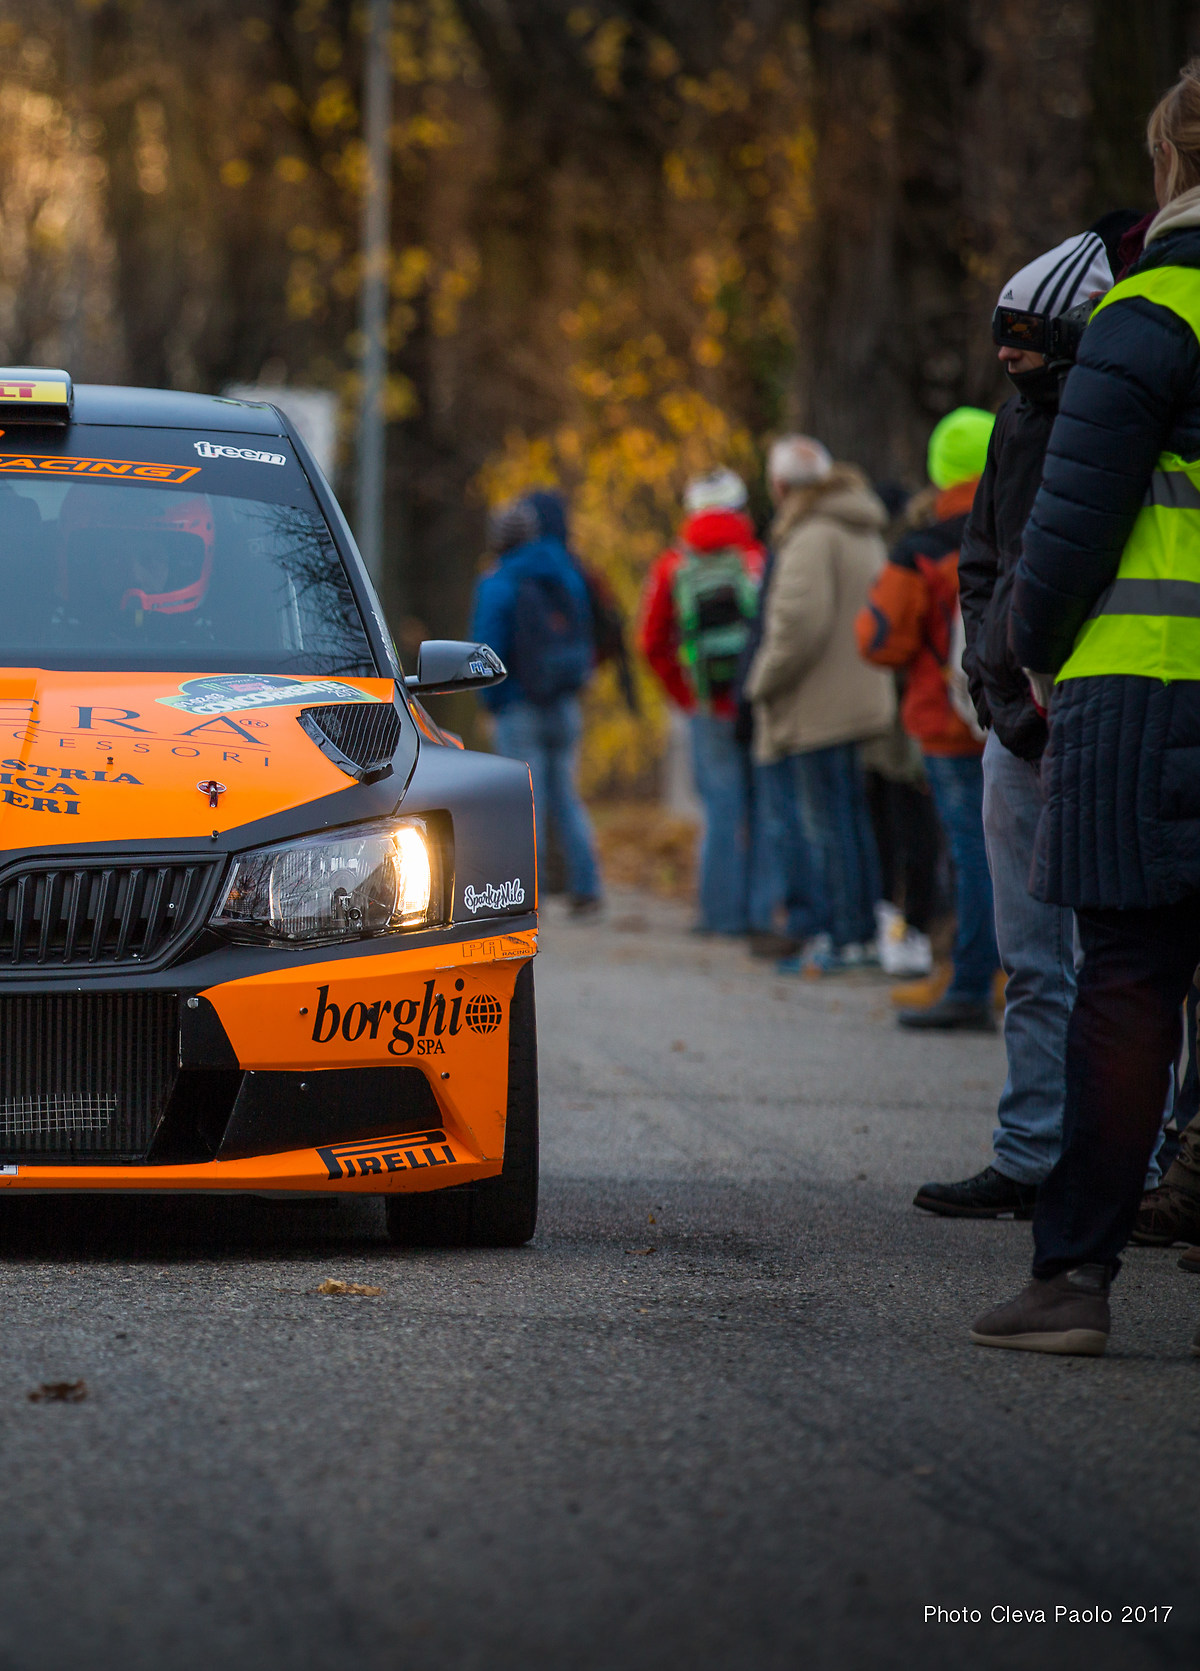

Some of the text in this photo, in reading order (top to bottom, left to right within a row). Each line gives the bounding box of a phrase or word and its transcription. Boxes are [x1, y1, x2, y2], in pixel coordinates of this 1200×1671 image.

[194, 441, 287, 466] freem
[311, 978, 466, 1056] borghi
[417, 1039, 447, 1055] SPA
[315, 1129, 457, 1181] PIRELLI
